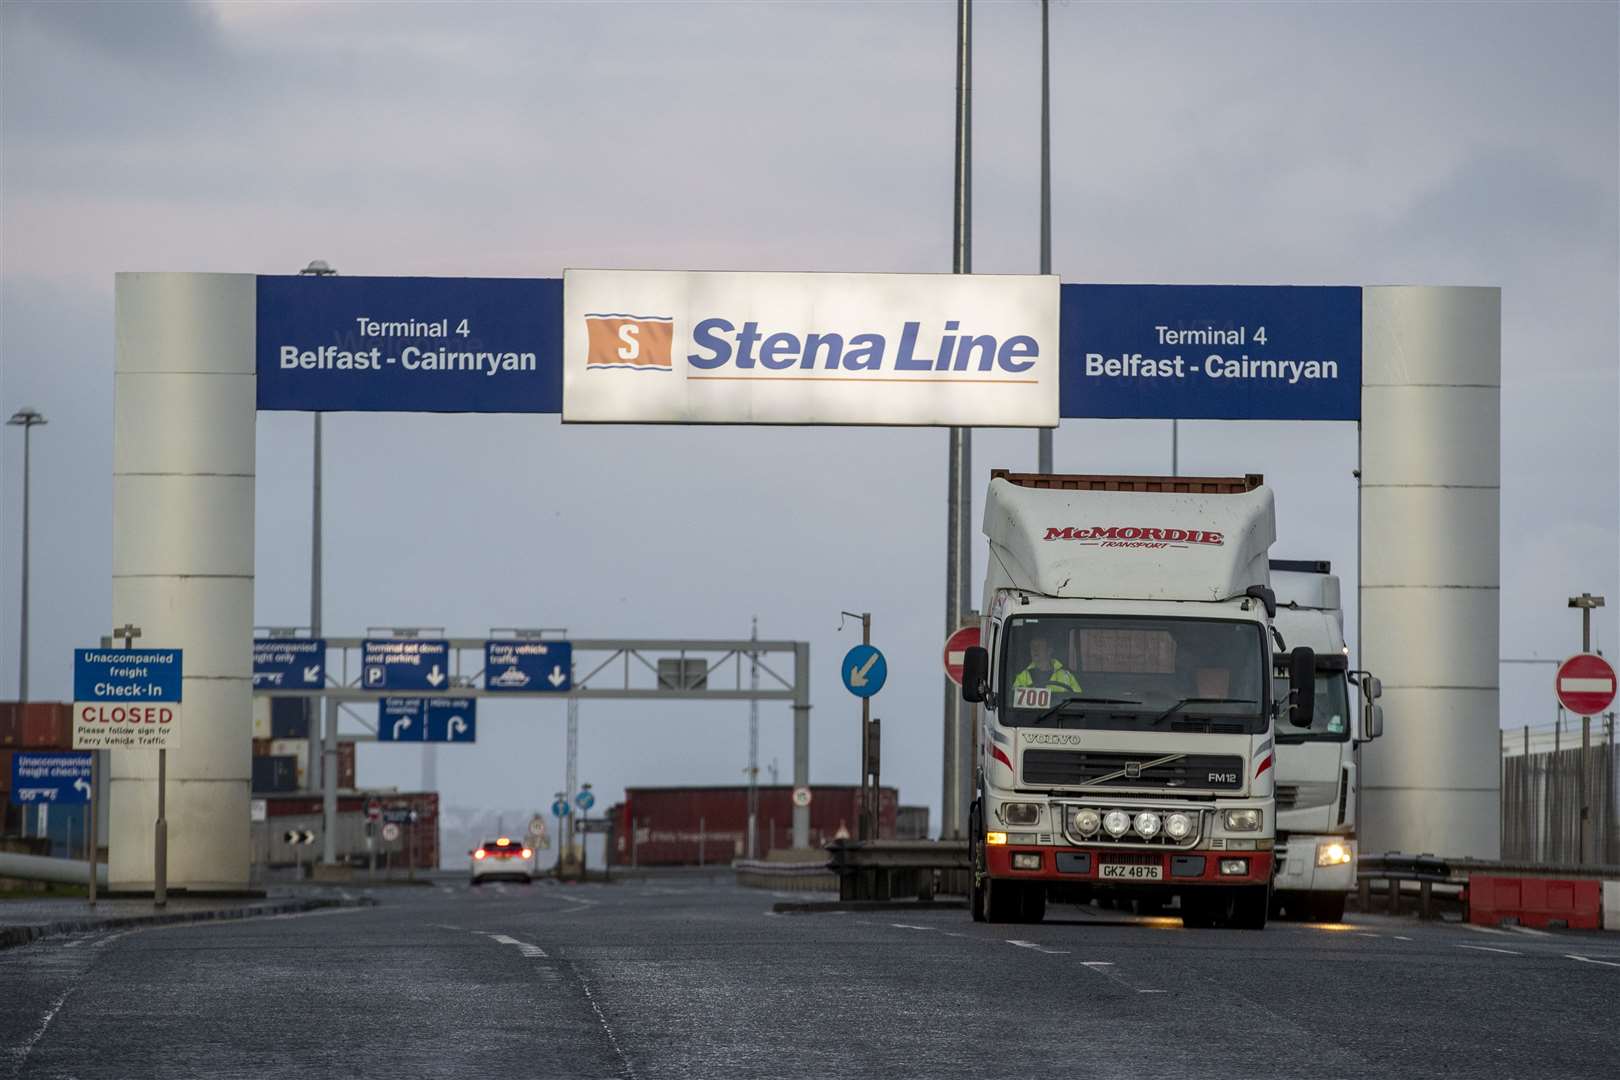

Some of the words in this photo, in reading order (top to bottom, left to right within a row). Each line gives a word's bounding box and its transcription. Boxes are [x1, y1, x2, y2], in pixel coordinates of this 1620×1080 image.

[356, 317, 448, 338] Terminal
[455, 318, 471, 338] 4
[617, 324, 640, 360] S
[1155, 326, 1245, 345] Terminal
[1252, 326, 1268, 346] 4
[686, 318, 886, 371] Stena
[893, 320, 1040, 374] Line
[280, 346, 381, 369] Belfast
[401, 346, 536, 376] Cairnryan
[1085, 353, 1184, 378] Belfast
[1205, 355, 1338, 384] Cairnryan
[1099, 541, 1168, 549] TRANSPORT
[366, 642, 403, 653] Terminal
[419, 643, 444, 654] down
[489, 643, 513, 655] Ferry
[515, 644, 548, 655] vehicle
[84, 652, 173, 664] Unaccompanied
[275, 653, 295, 664] only
[365, 654, 384, 664] and
[385, 654, 421, 666] parking
[489, 655, 518, 665] traffic
[109, 667, 148, 679] freight
[368, 668, 382, 685] P
[94, 683, 162, 697] Check-In
[1016, 688, 1049, 707] 700
[81, 706, 173, 724] CLOSED
[78, 726, 106, 735] Please
[108, 726, 134, 735] follow
[137, 726, 155, 736] sign
[158, 726, 171, 735] for
[78, 736, 101, 746] Ferry
[104, 736, 135, 745] Vehicle
[138, 736, 166, 745] Traffic
[1022, 733, 1081, 745] VOLVO
[18, 756, 92, 768] Unaccompanied
[18, 767, 49, 778] freight
[1103, 865, 1126, 877] GKZ
[1129, 866, 1158, 878] 4876
